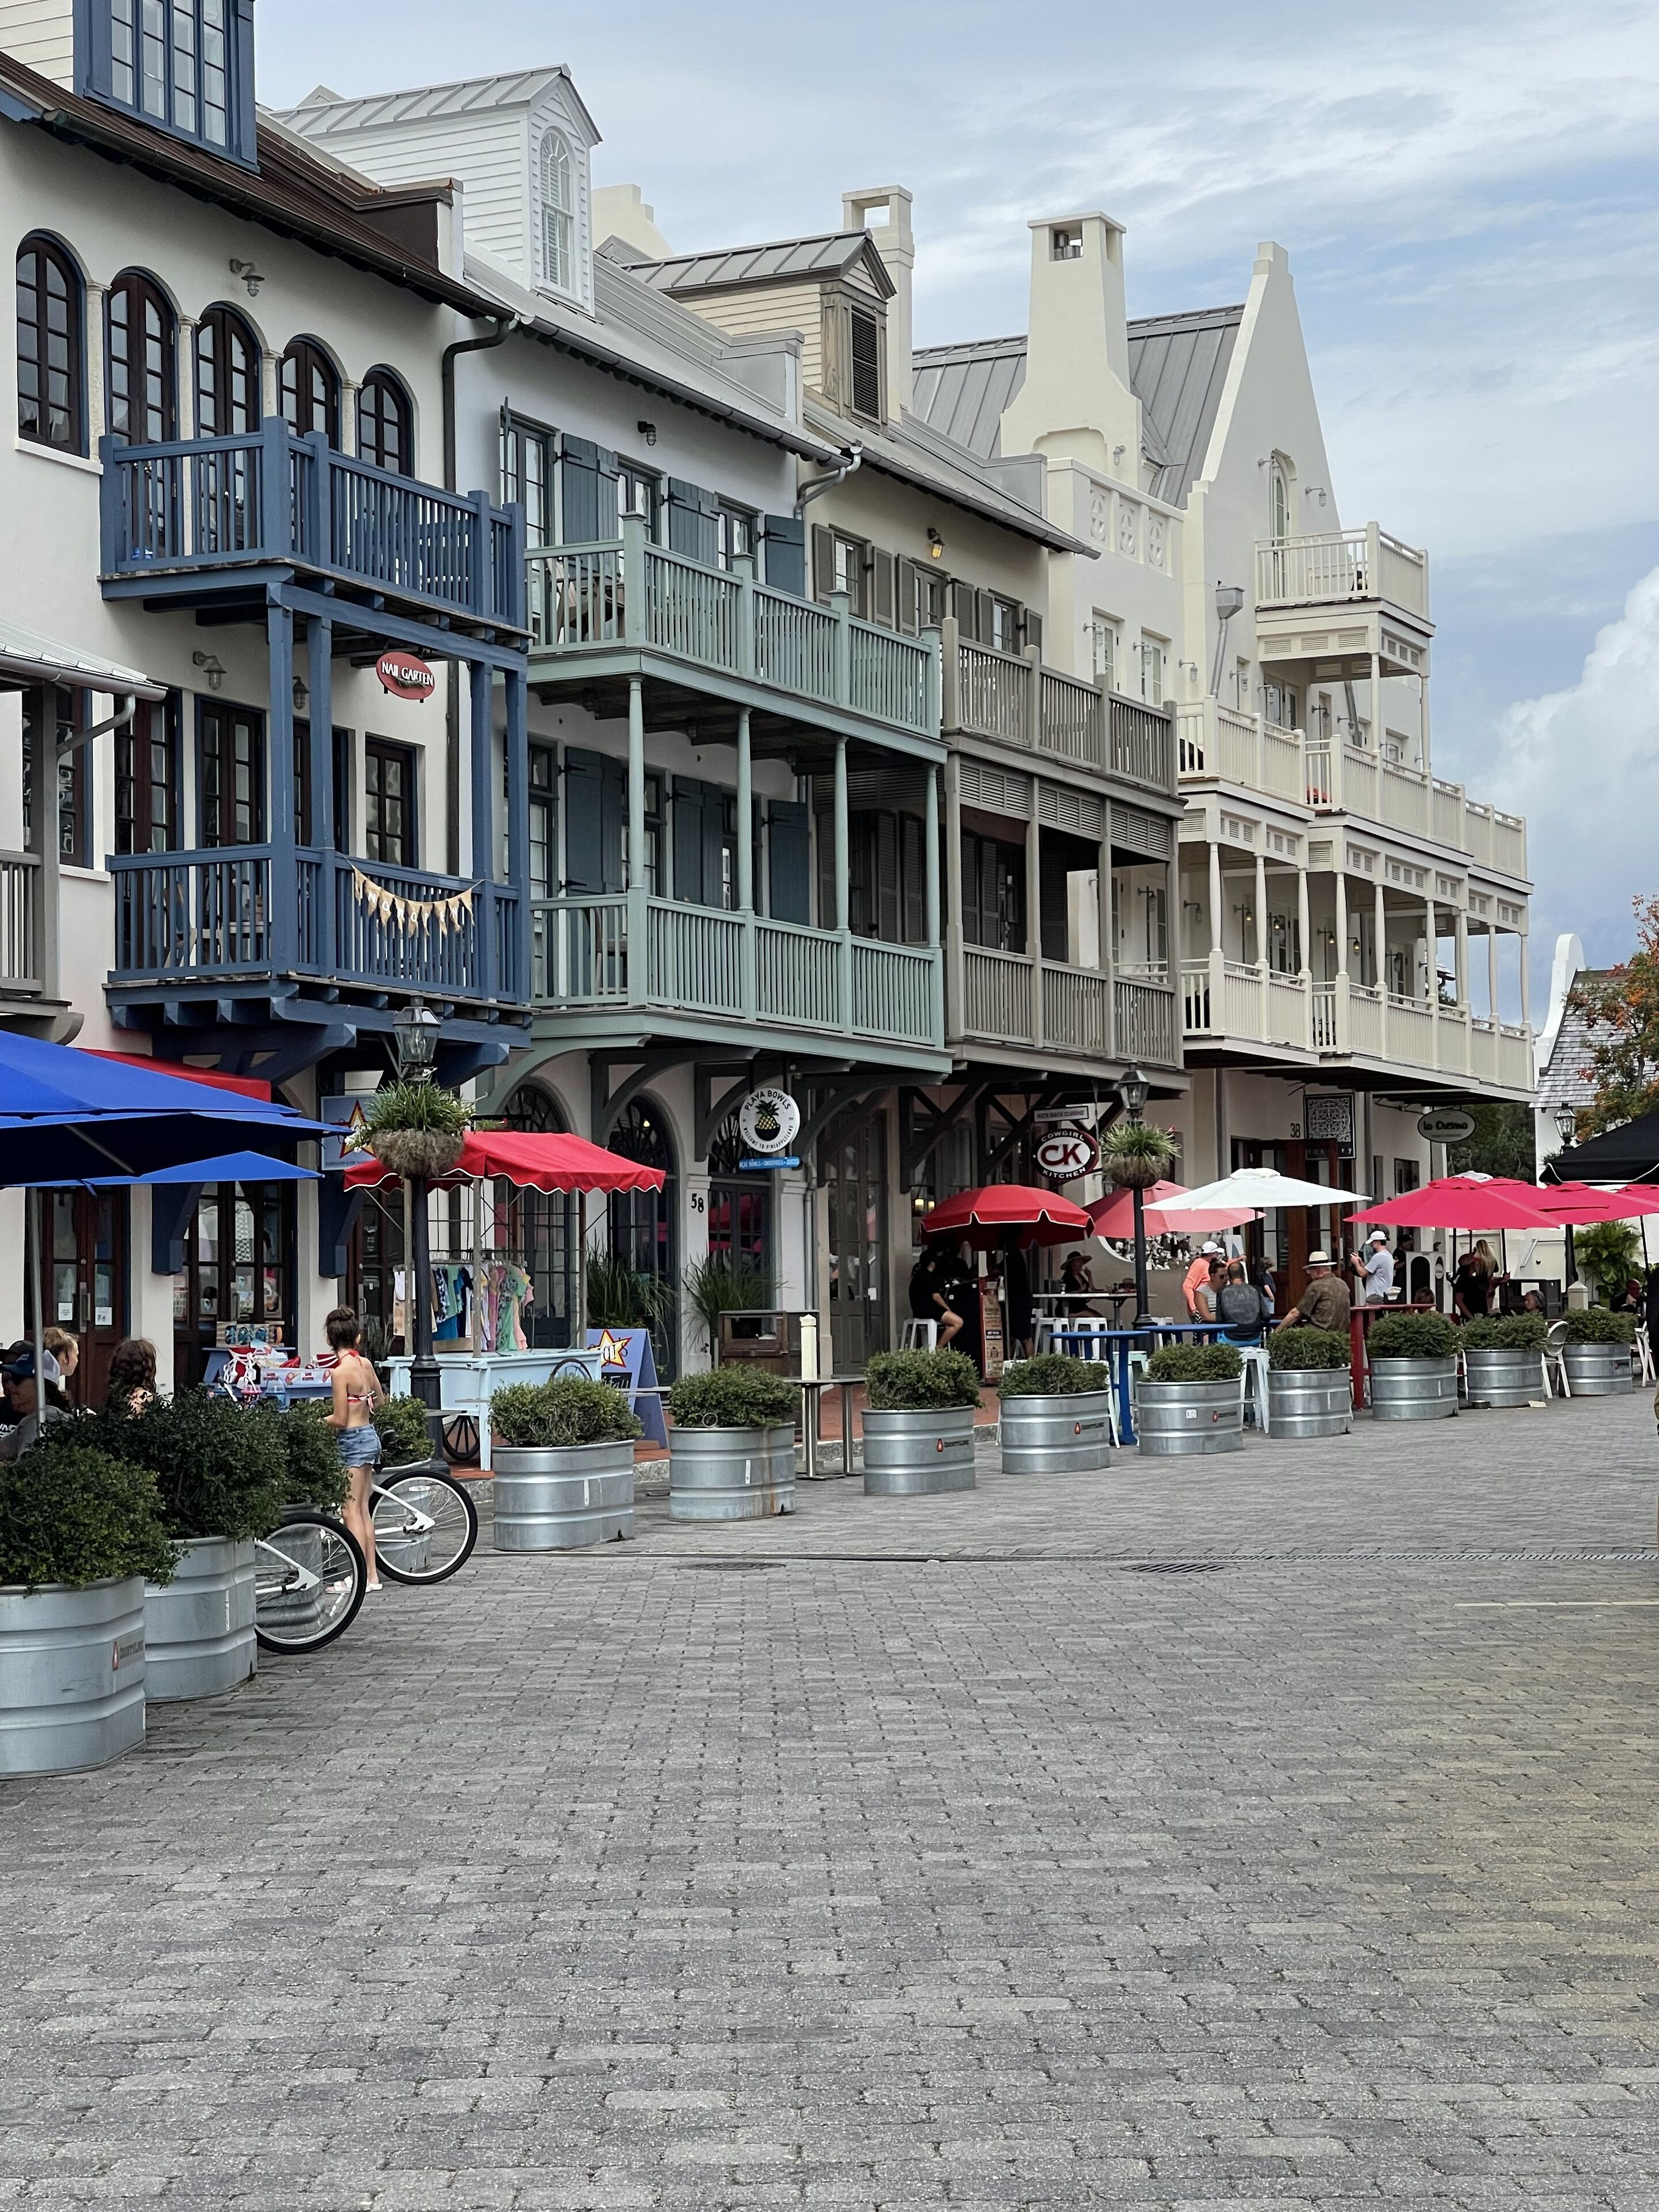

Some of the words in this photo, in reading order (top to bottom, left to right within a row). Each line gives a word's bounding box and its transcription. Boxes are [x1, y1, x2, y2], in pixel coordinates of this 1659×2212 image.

[401, 666, 433, 687] GARTEN
[744, 1090, 766, 1111] PLAYA
[767, 1090, 791, 1110] BOWLS
[743, 1127, 759, 1146] WELCOME
[1041, 1130, 1085, 1142] COWGIRL
[1290, 1123, 1301, 1138] 38
[1040, 1143, 1082, 1166] CK
[1042, 1166, 1086, 1179] KITCHEN
[691, 1193, 704, 1213] 58
